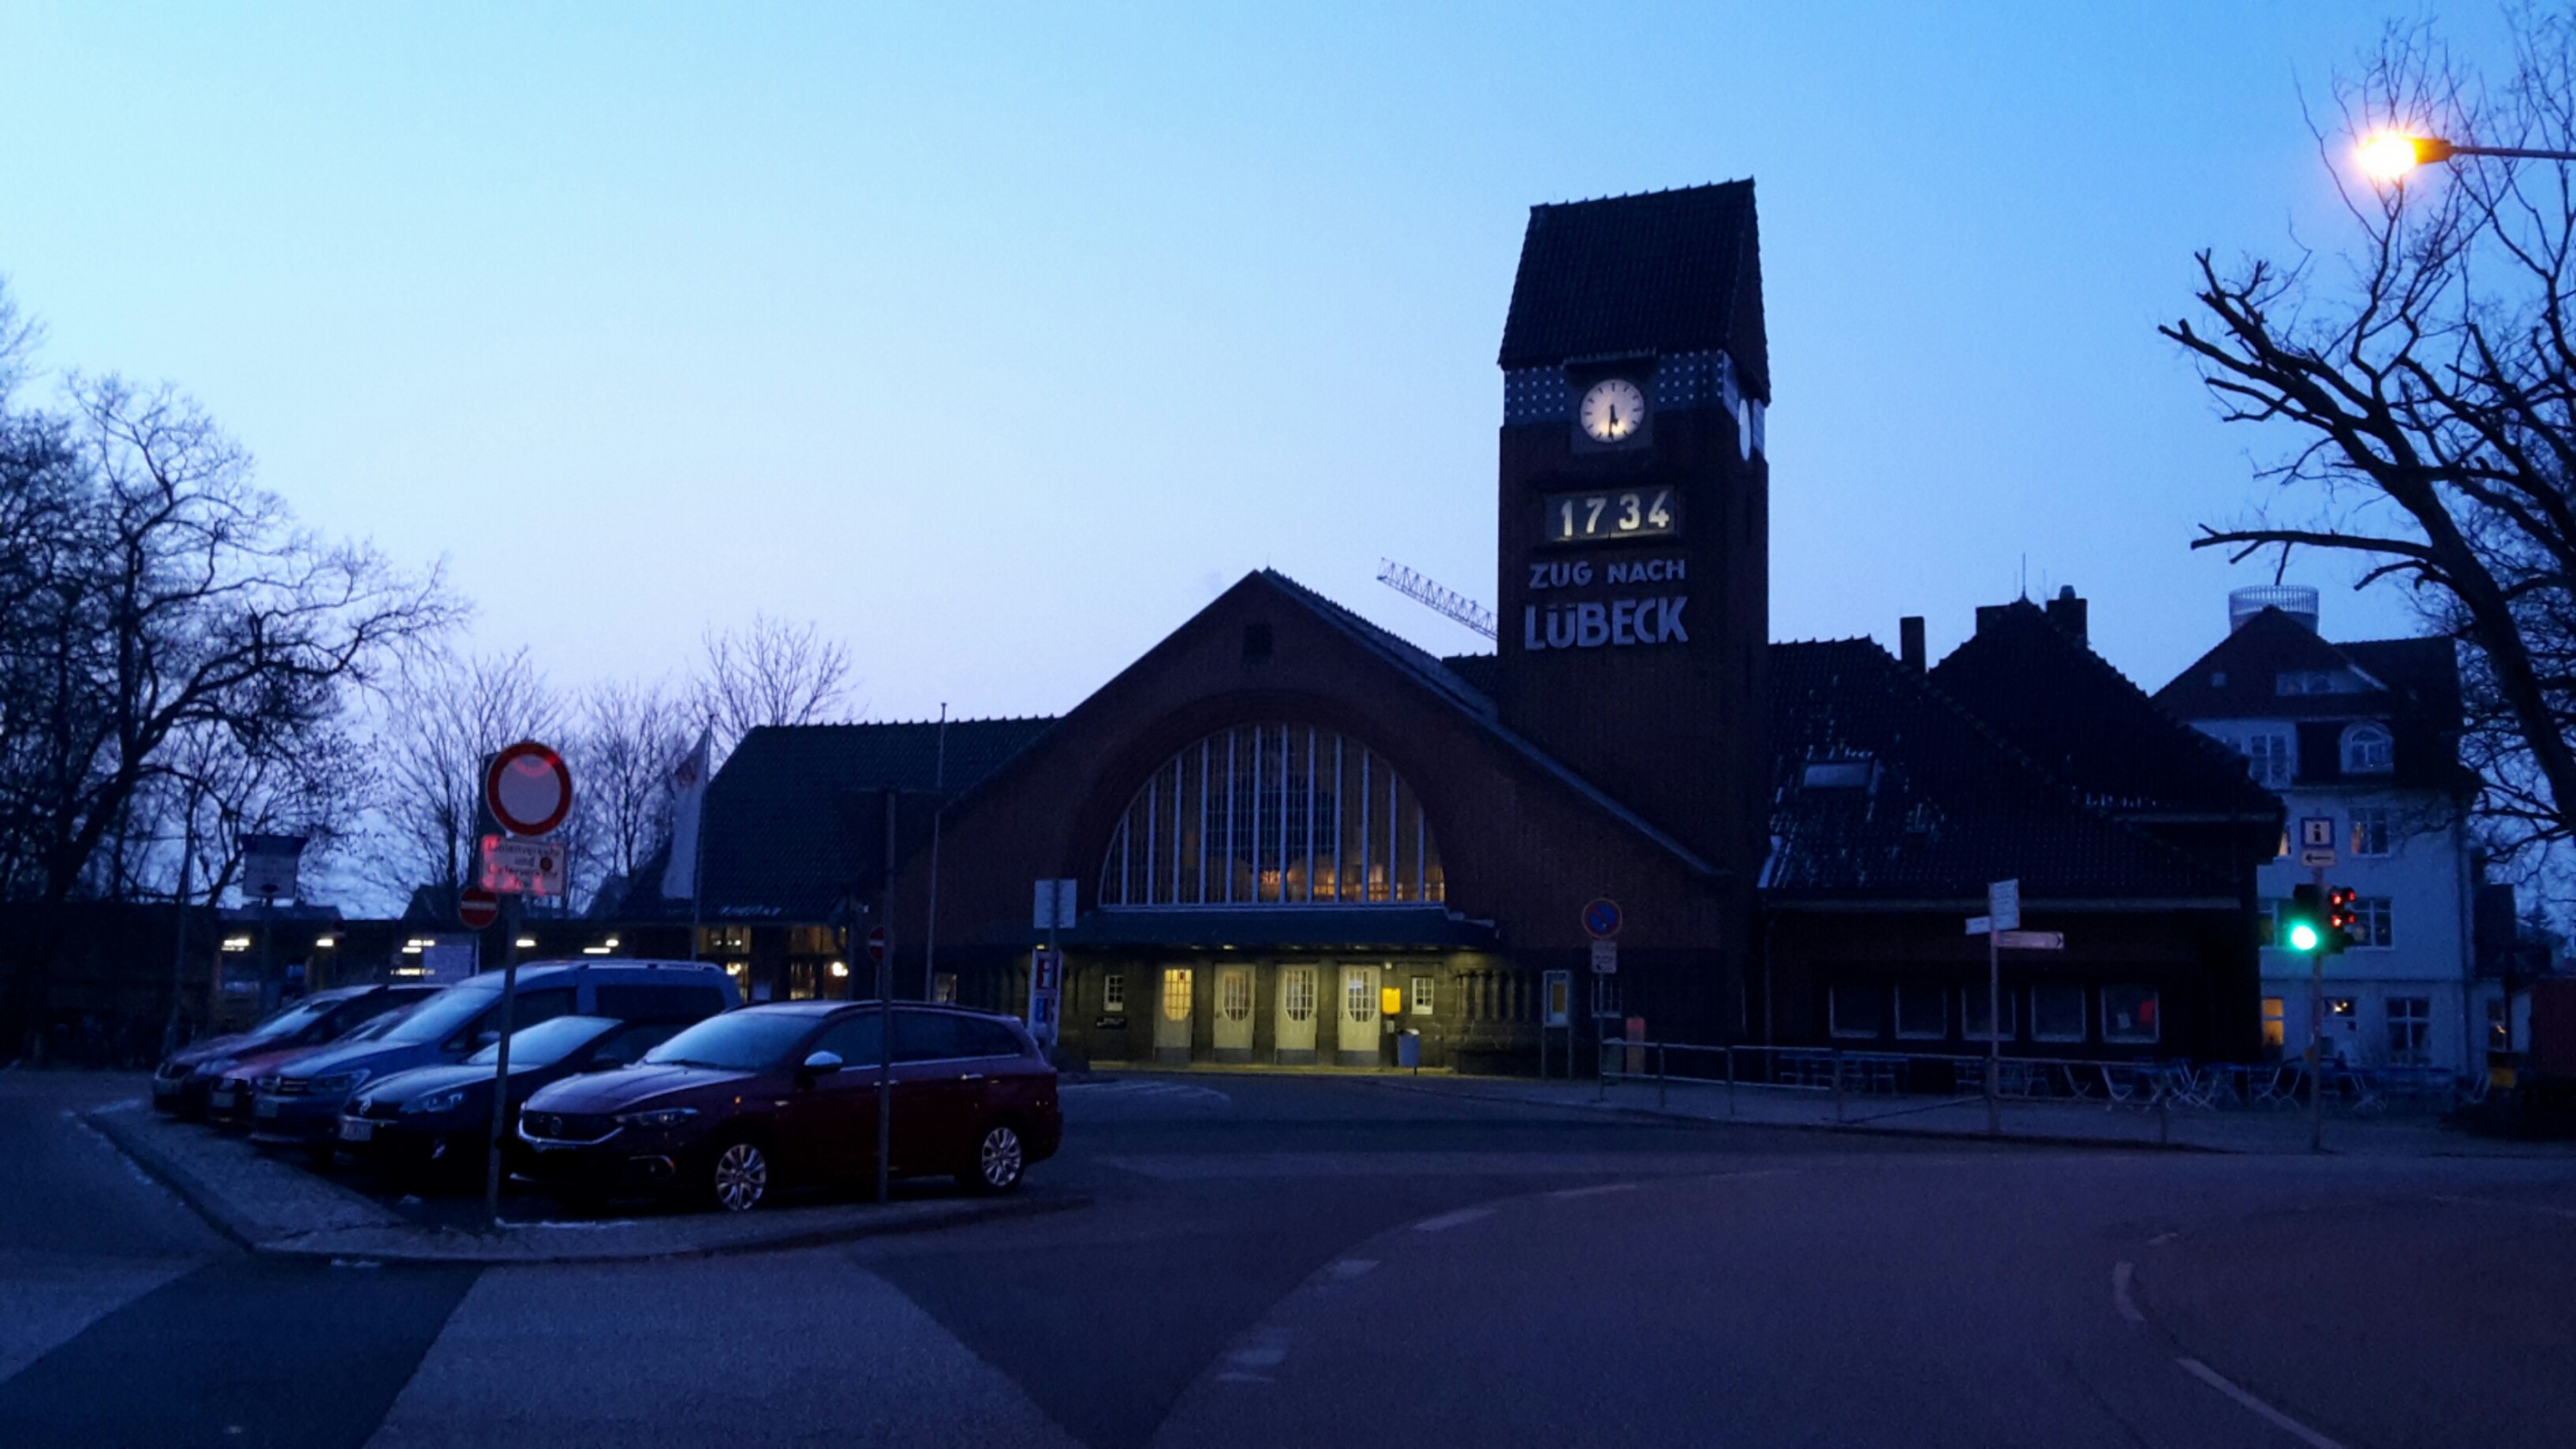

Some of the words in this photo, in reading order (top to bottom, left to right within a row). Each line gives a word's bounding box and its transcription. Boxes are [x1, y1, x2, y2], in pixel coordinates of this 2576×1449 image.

[1528, 562, 1593, 590] ZUG
[1607, 559, 1686, 585] NACH
[1524, 597, 1689, 652] LÜBECK
